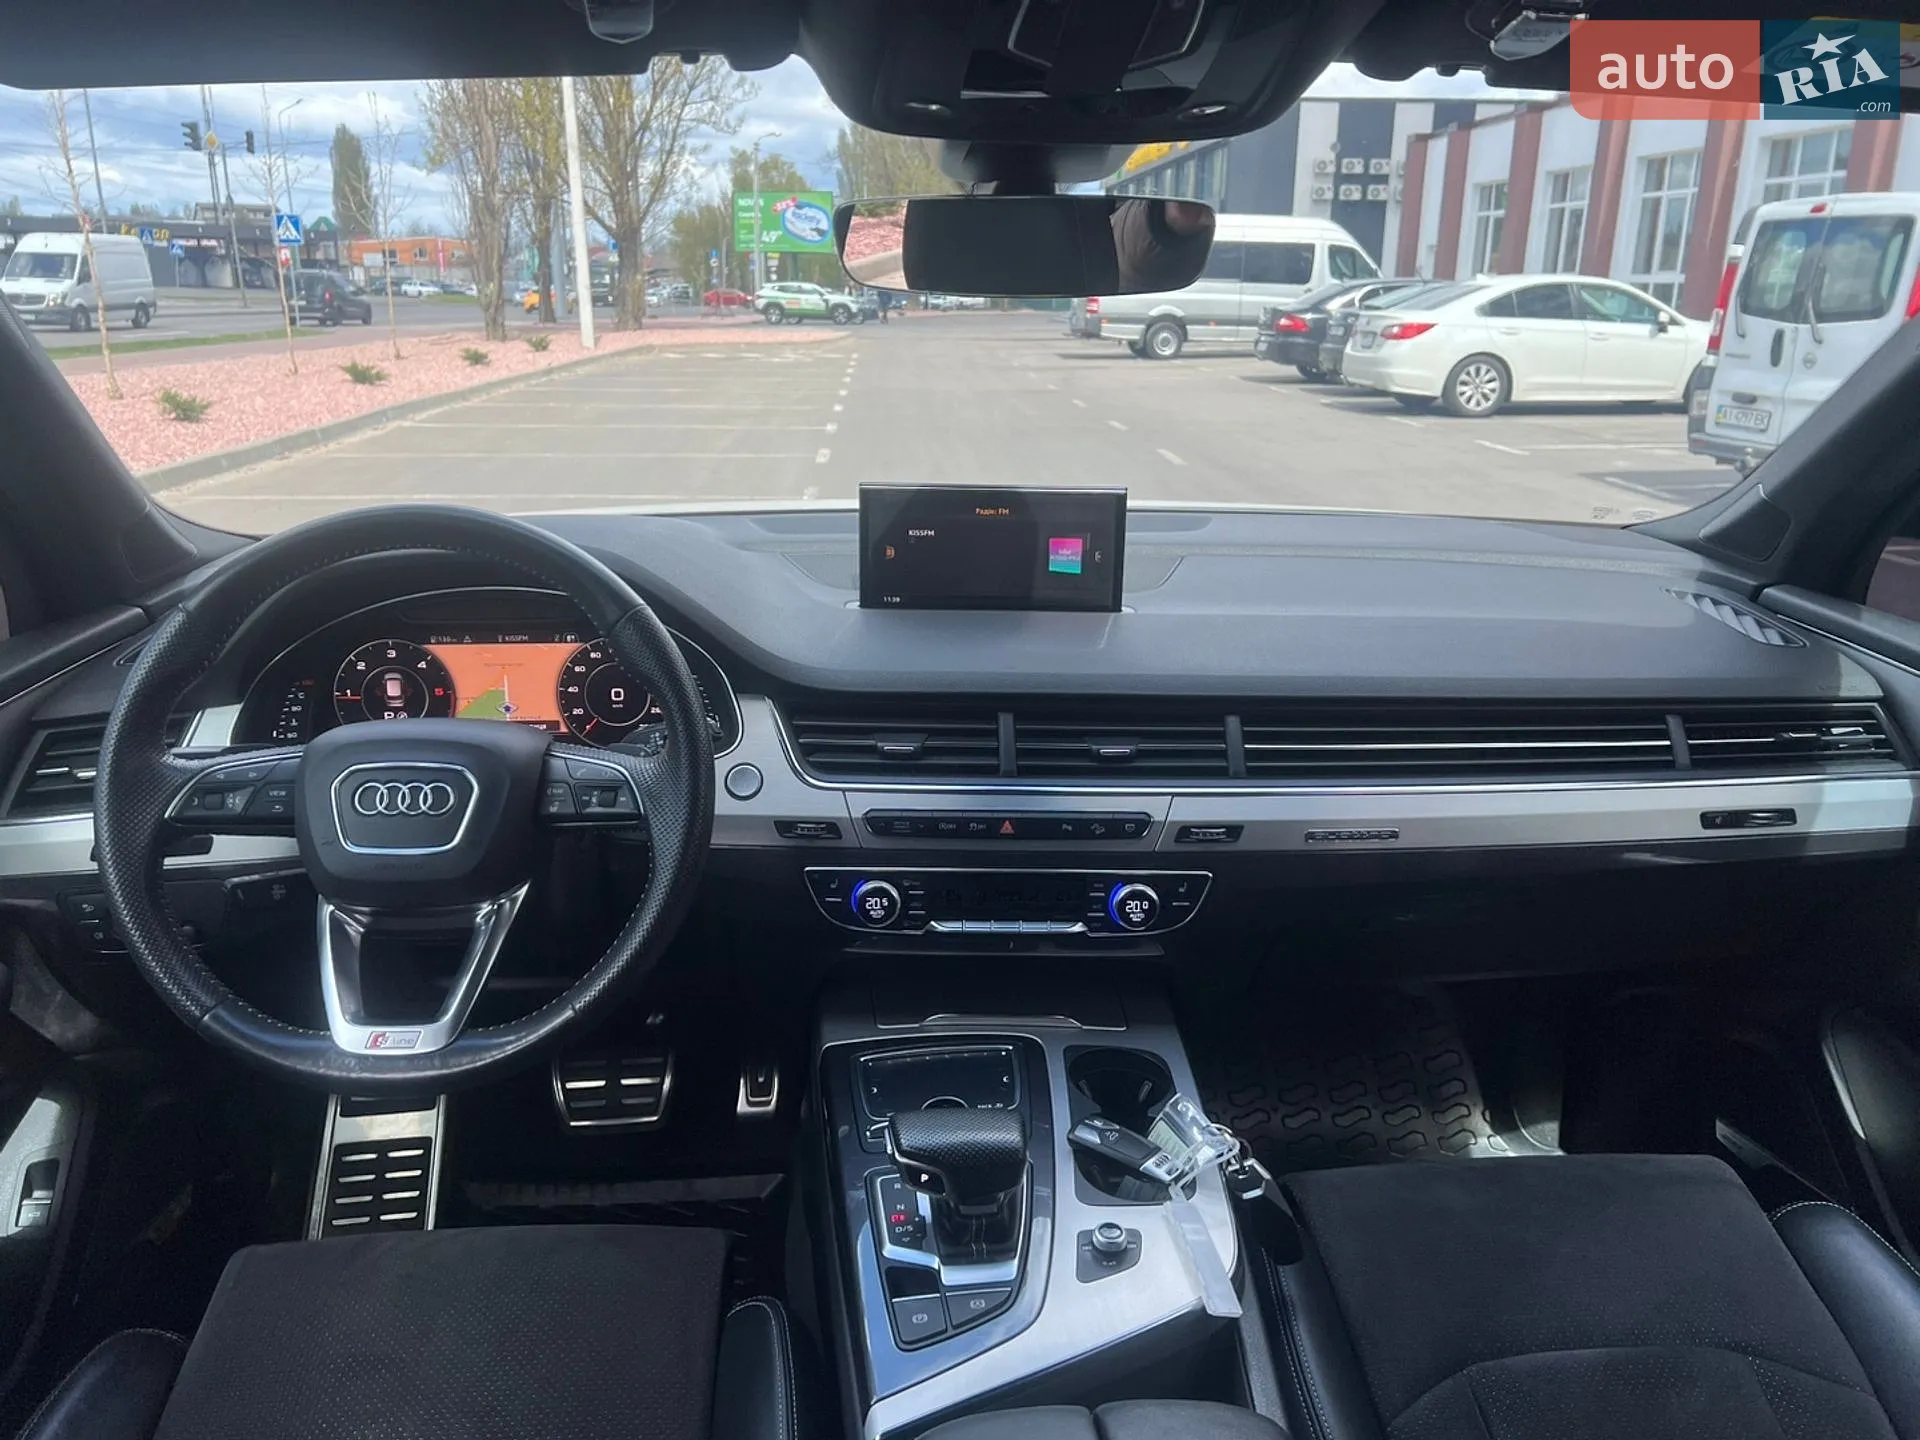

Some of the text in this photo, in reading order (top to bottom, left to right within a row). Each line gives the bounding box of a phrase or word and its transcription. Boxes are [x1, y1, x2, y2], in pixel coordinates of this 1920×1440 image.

[738, 198, 765, 206] NOVS
[387, 649, 397, 659] 3
[356, 661, 367, 671] 2
[417, 661, 428, 669] 4
[383, 711, 395, 720] P
[920, 1173, 929, 1183] P
